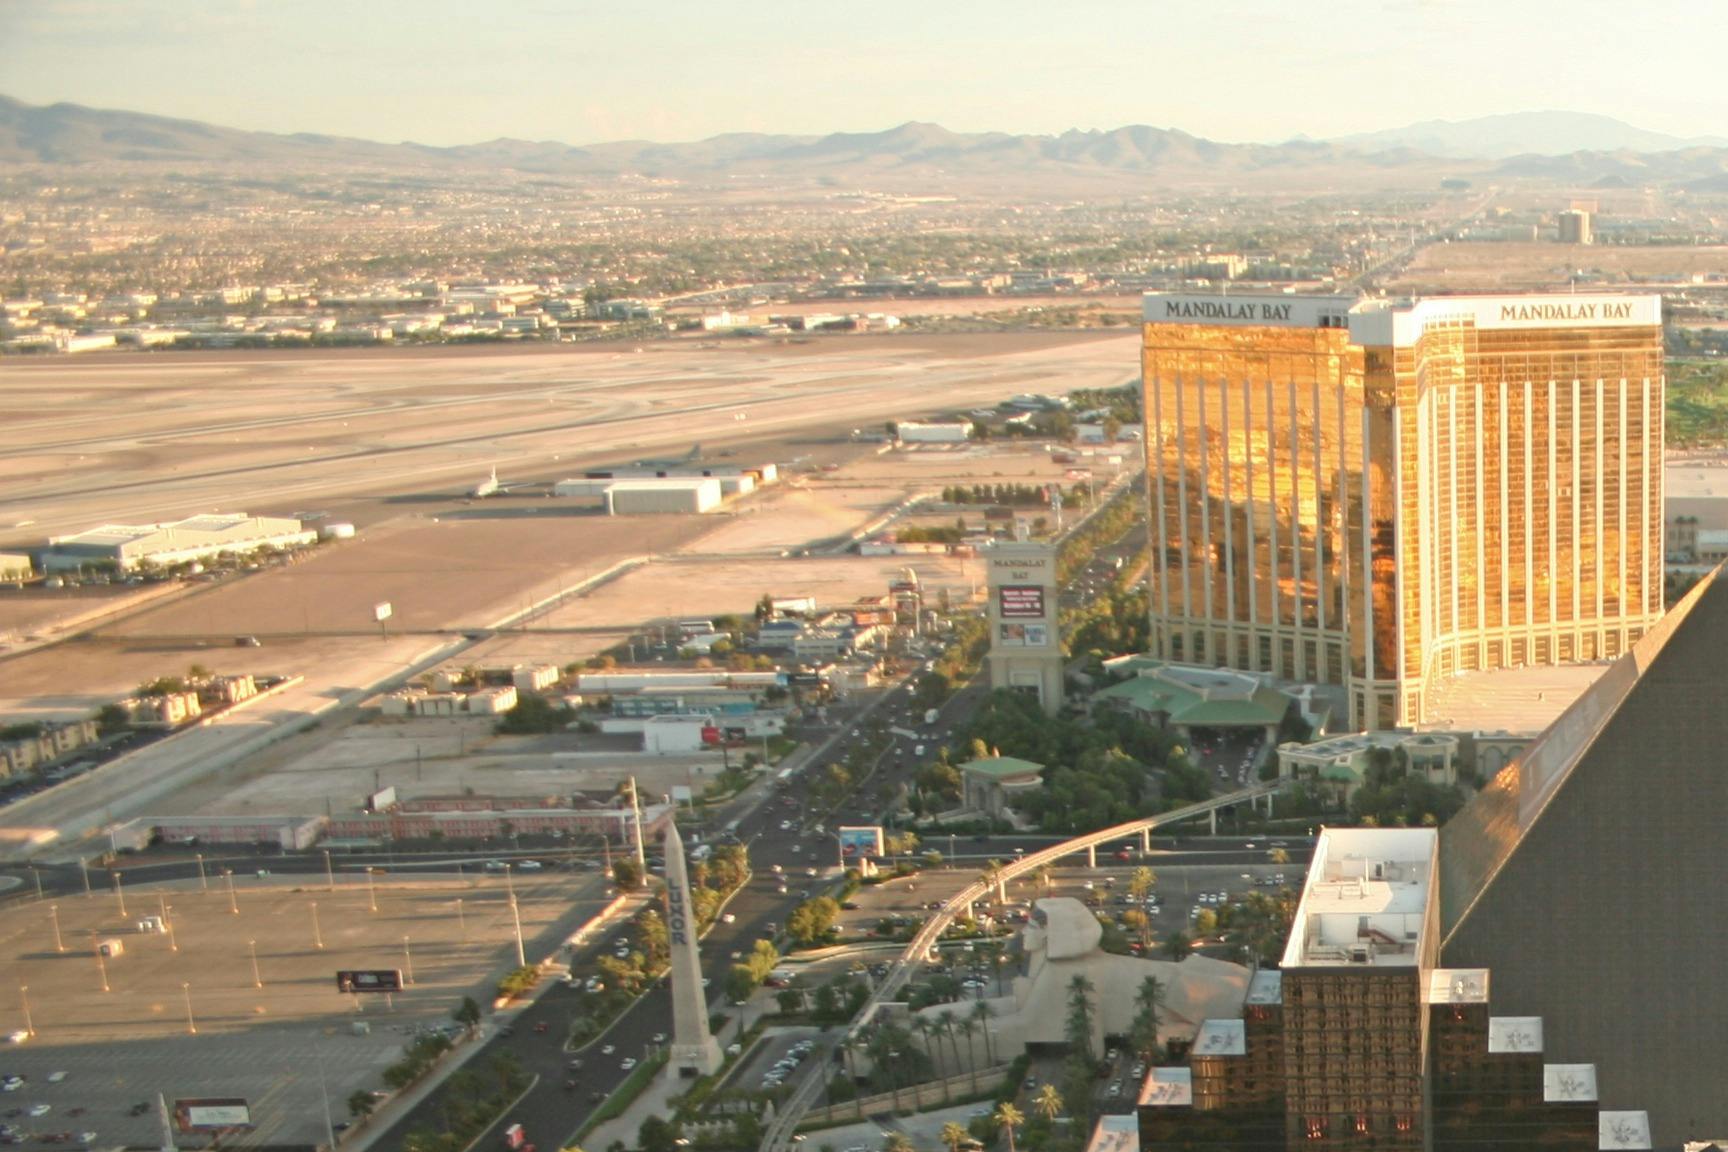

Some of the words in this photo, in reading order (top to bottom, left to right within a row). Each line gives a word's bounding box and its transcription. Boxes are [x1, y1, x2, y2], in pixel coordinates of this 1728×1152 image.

[1166, 301, 1256, 319] MANDALAY
[1262, 304, 1292, 320] BAY
[1501, 303, 1597, 321] MANDALAY
[1603, 303, 1632, 319] BAY
[668, 878, 687, 944] LUXOR
